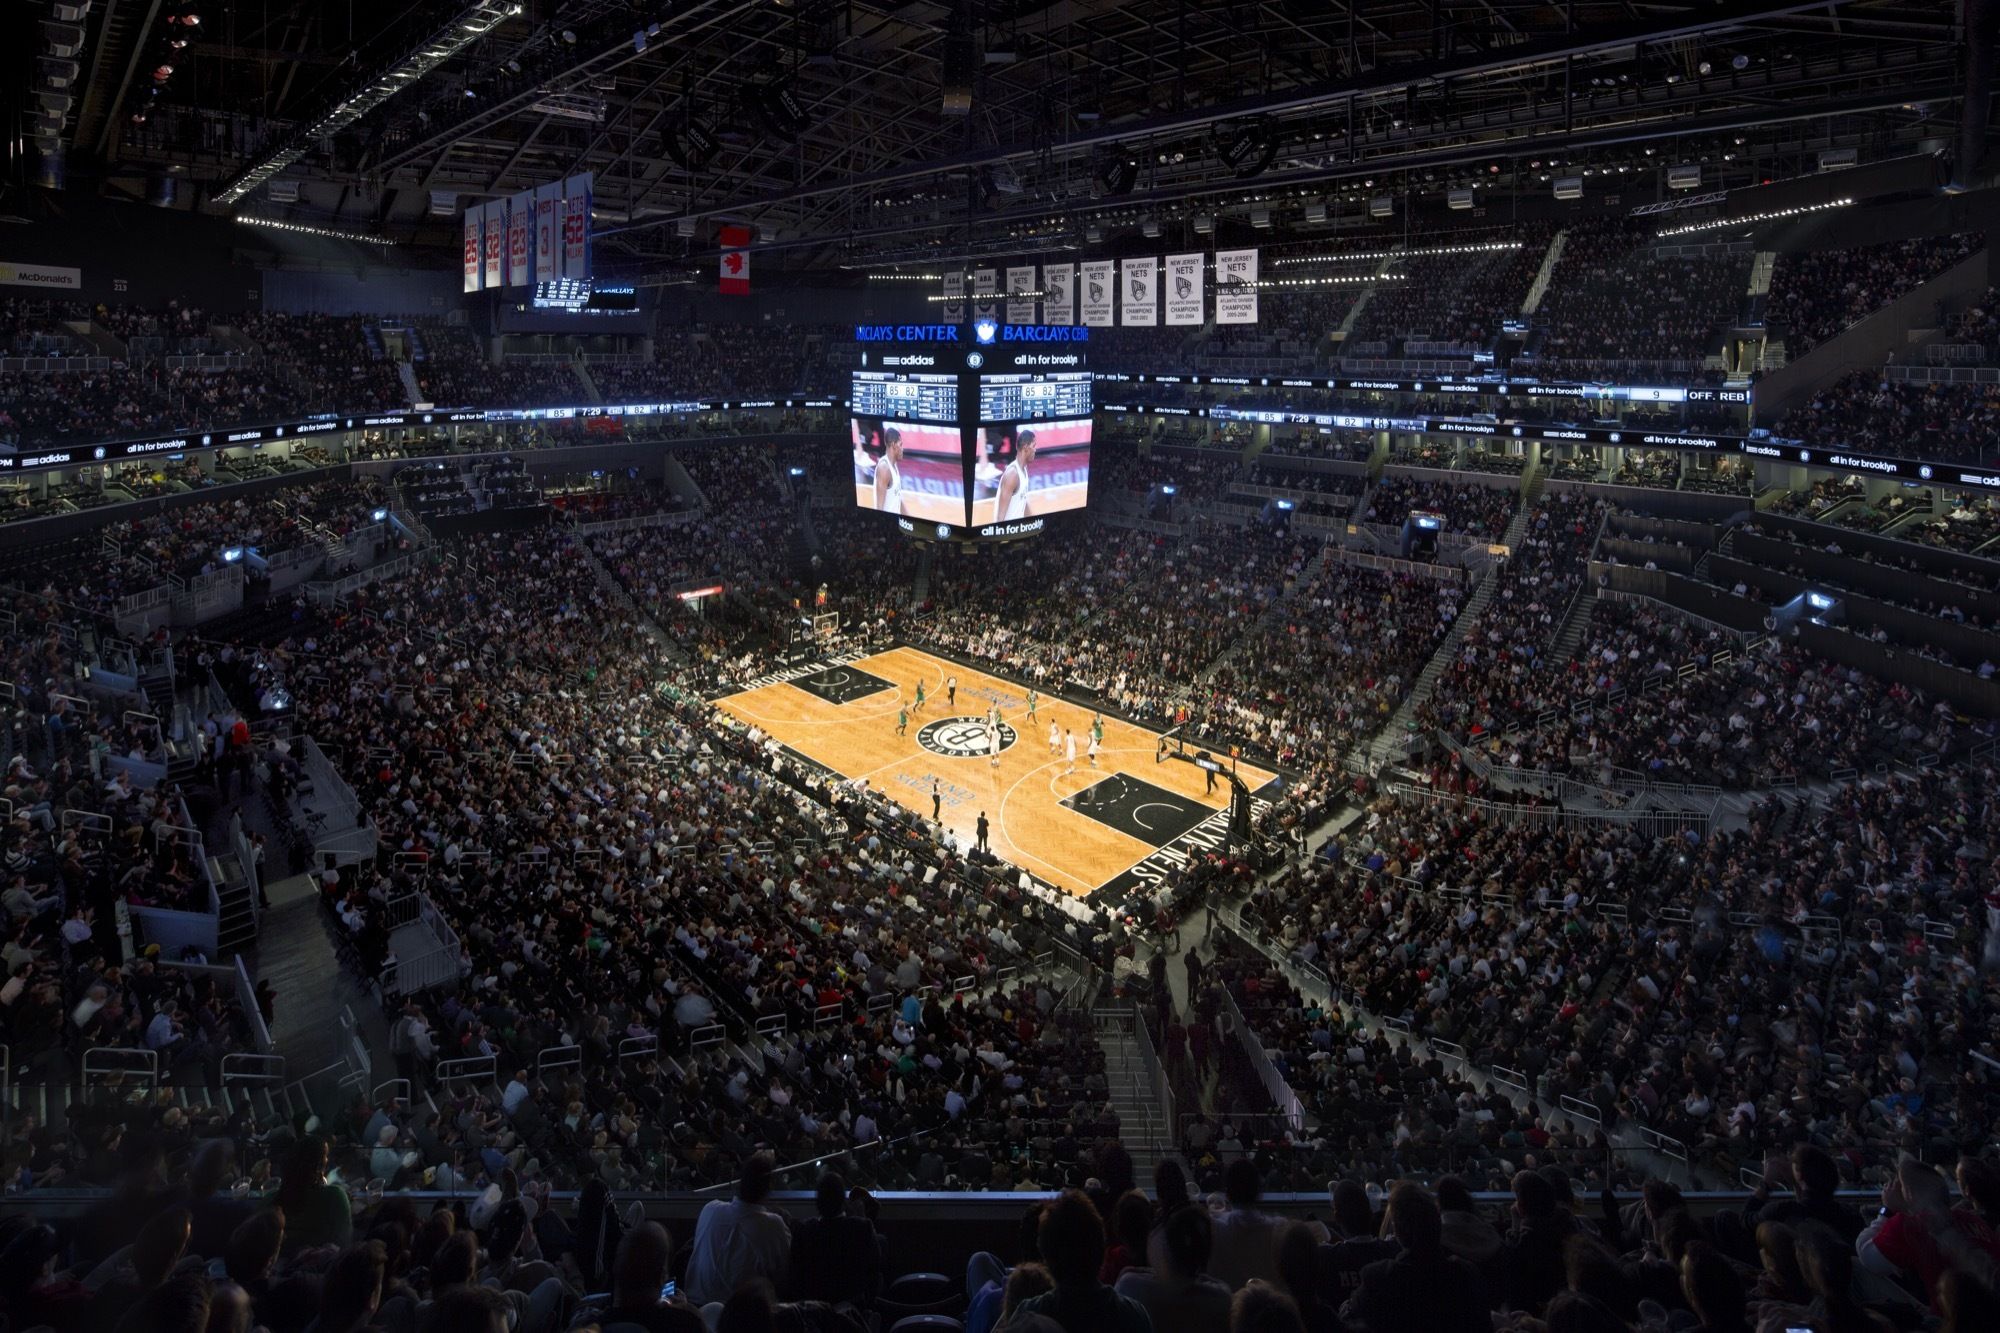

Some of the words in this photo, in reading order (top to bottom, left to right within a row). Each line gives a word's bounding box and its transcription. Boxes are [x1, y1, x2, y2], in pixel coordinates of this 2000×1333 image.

[566, 214, 583, 245] 52
[486, 234, 500, 260] 32
[512, 228, 526, 256] 23
[541, 226, 548, 257] 3
[465, 238, 477, 264] 25
[1228, 262, 1246, 272] NETS
[18, 272, 73, 284] McDonald's
[114, 284, 128, 292] 213
[897, 326, 958, 341] CENTER
[1004, 326, 1069, 341] BARCLAYS
[901, 355, 934, 365] adidas
[1015, 354, 1026, 364] all
[1028, 355, 1036, 364] in
[1038, 355, 1050, 364] for
[1052, 353, 1078, 366] brooklyn
[890, 386, 898, 395] 85
[906, 387, 914, 396] 82
[1026, 387, 1035, 396] 85
[1043, 386, 1052, 396] 82
[1690, 392, 1715, 400] OFF.
[1720, 393, 1744, 401] REB
[582, 408, 600, 416] 7:29
[128, 444, 136, 453] all
[157, 440, 186, 449] brooklyn
[1678, 438, 1716, 447] brooklyn
[1758, 447, 1780, 456] adidas
[40, 454, 70, 464] adidas
[1849, 458, 1860, 466] for
[1861, 460, 1896, 472] brooklyn
[981, 526, 994, 536] all
[996, 526, 1004, 535] in
[1006, 525, 1019, 535] for
[738, 663, 828, 690] BROOKLYN
[827, 650, 870, 666] NETS
[919, 728, 984, 757] BROOKLYN
